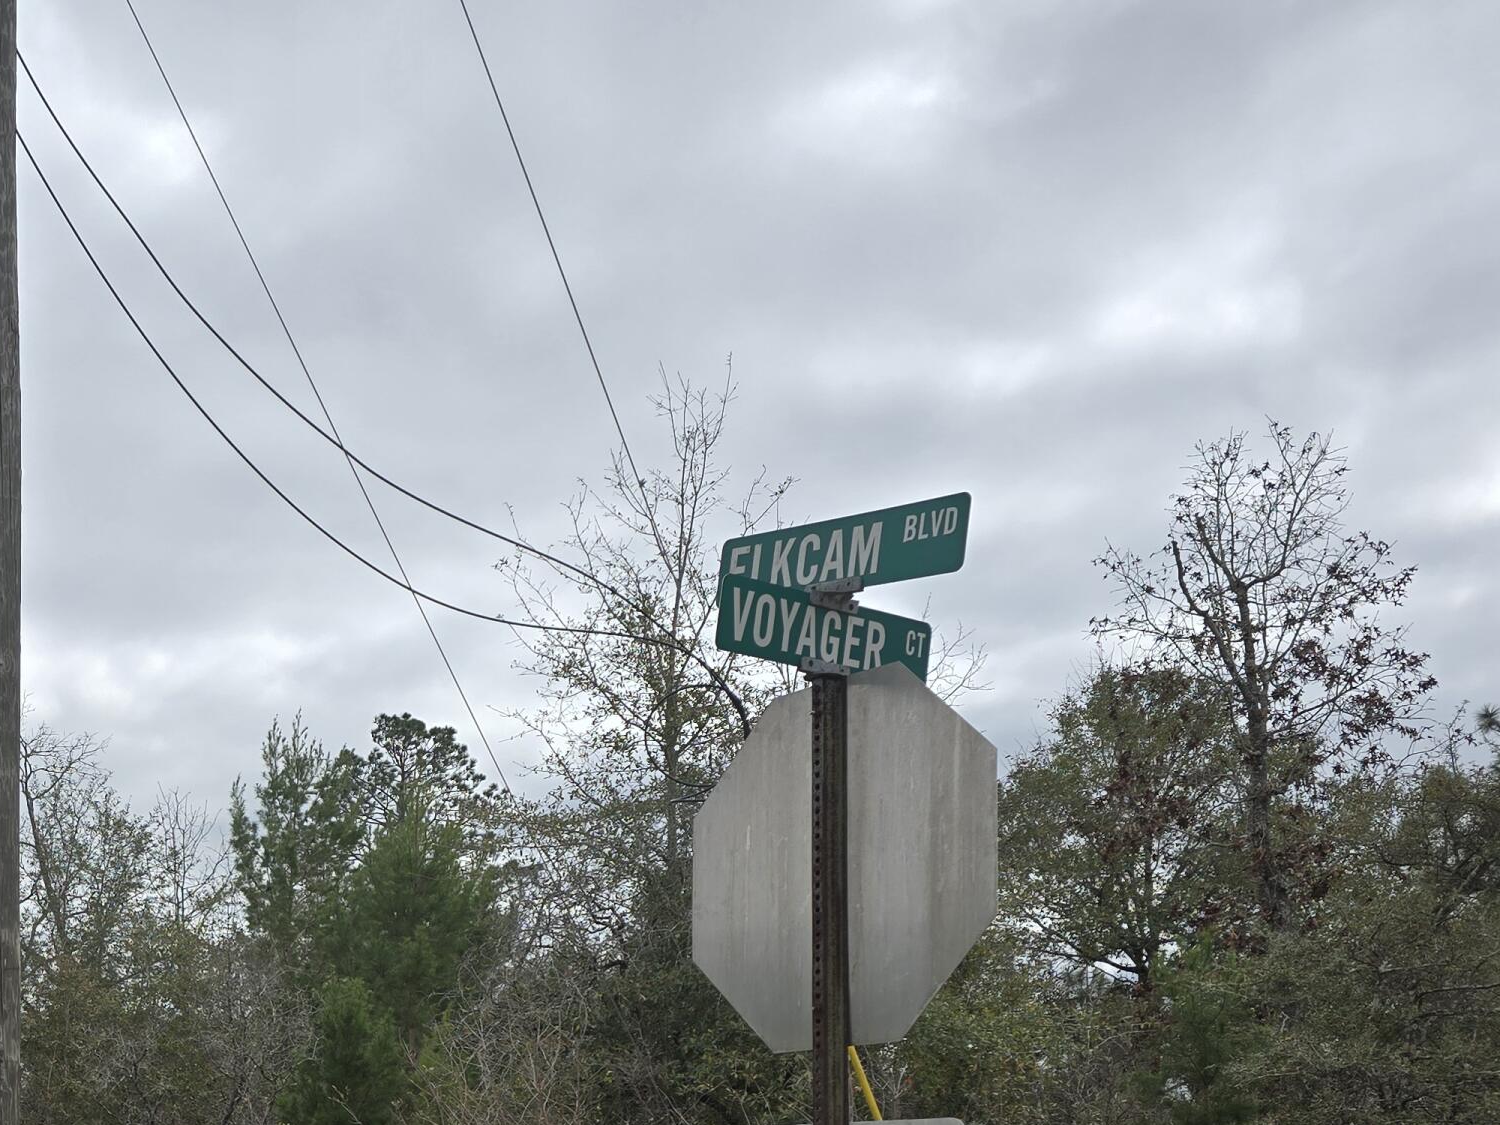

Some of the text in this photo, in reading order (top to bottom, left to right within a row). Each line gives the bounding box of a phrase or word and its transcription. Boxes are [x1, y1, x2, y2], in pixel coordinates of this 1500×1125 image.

[729, 506, 958, 587] ELKCAM BLVD
[733, 587, 927, 671] VOYAGER CT
